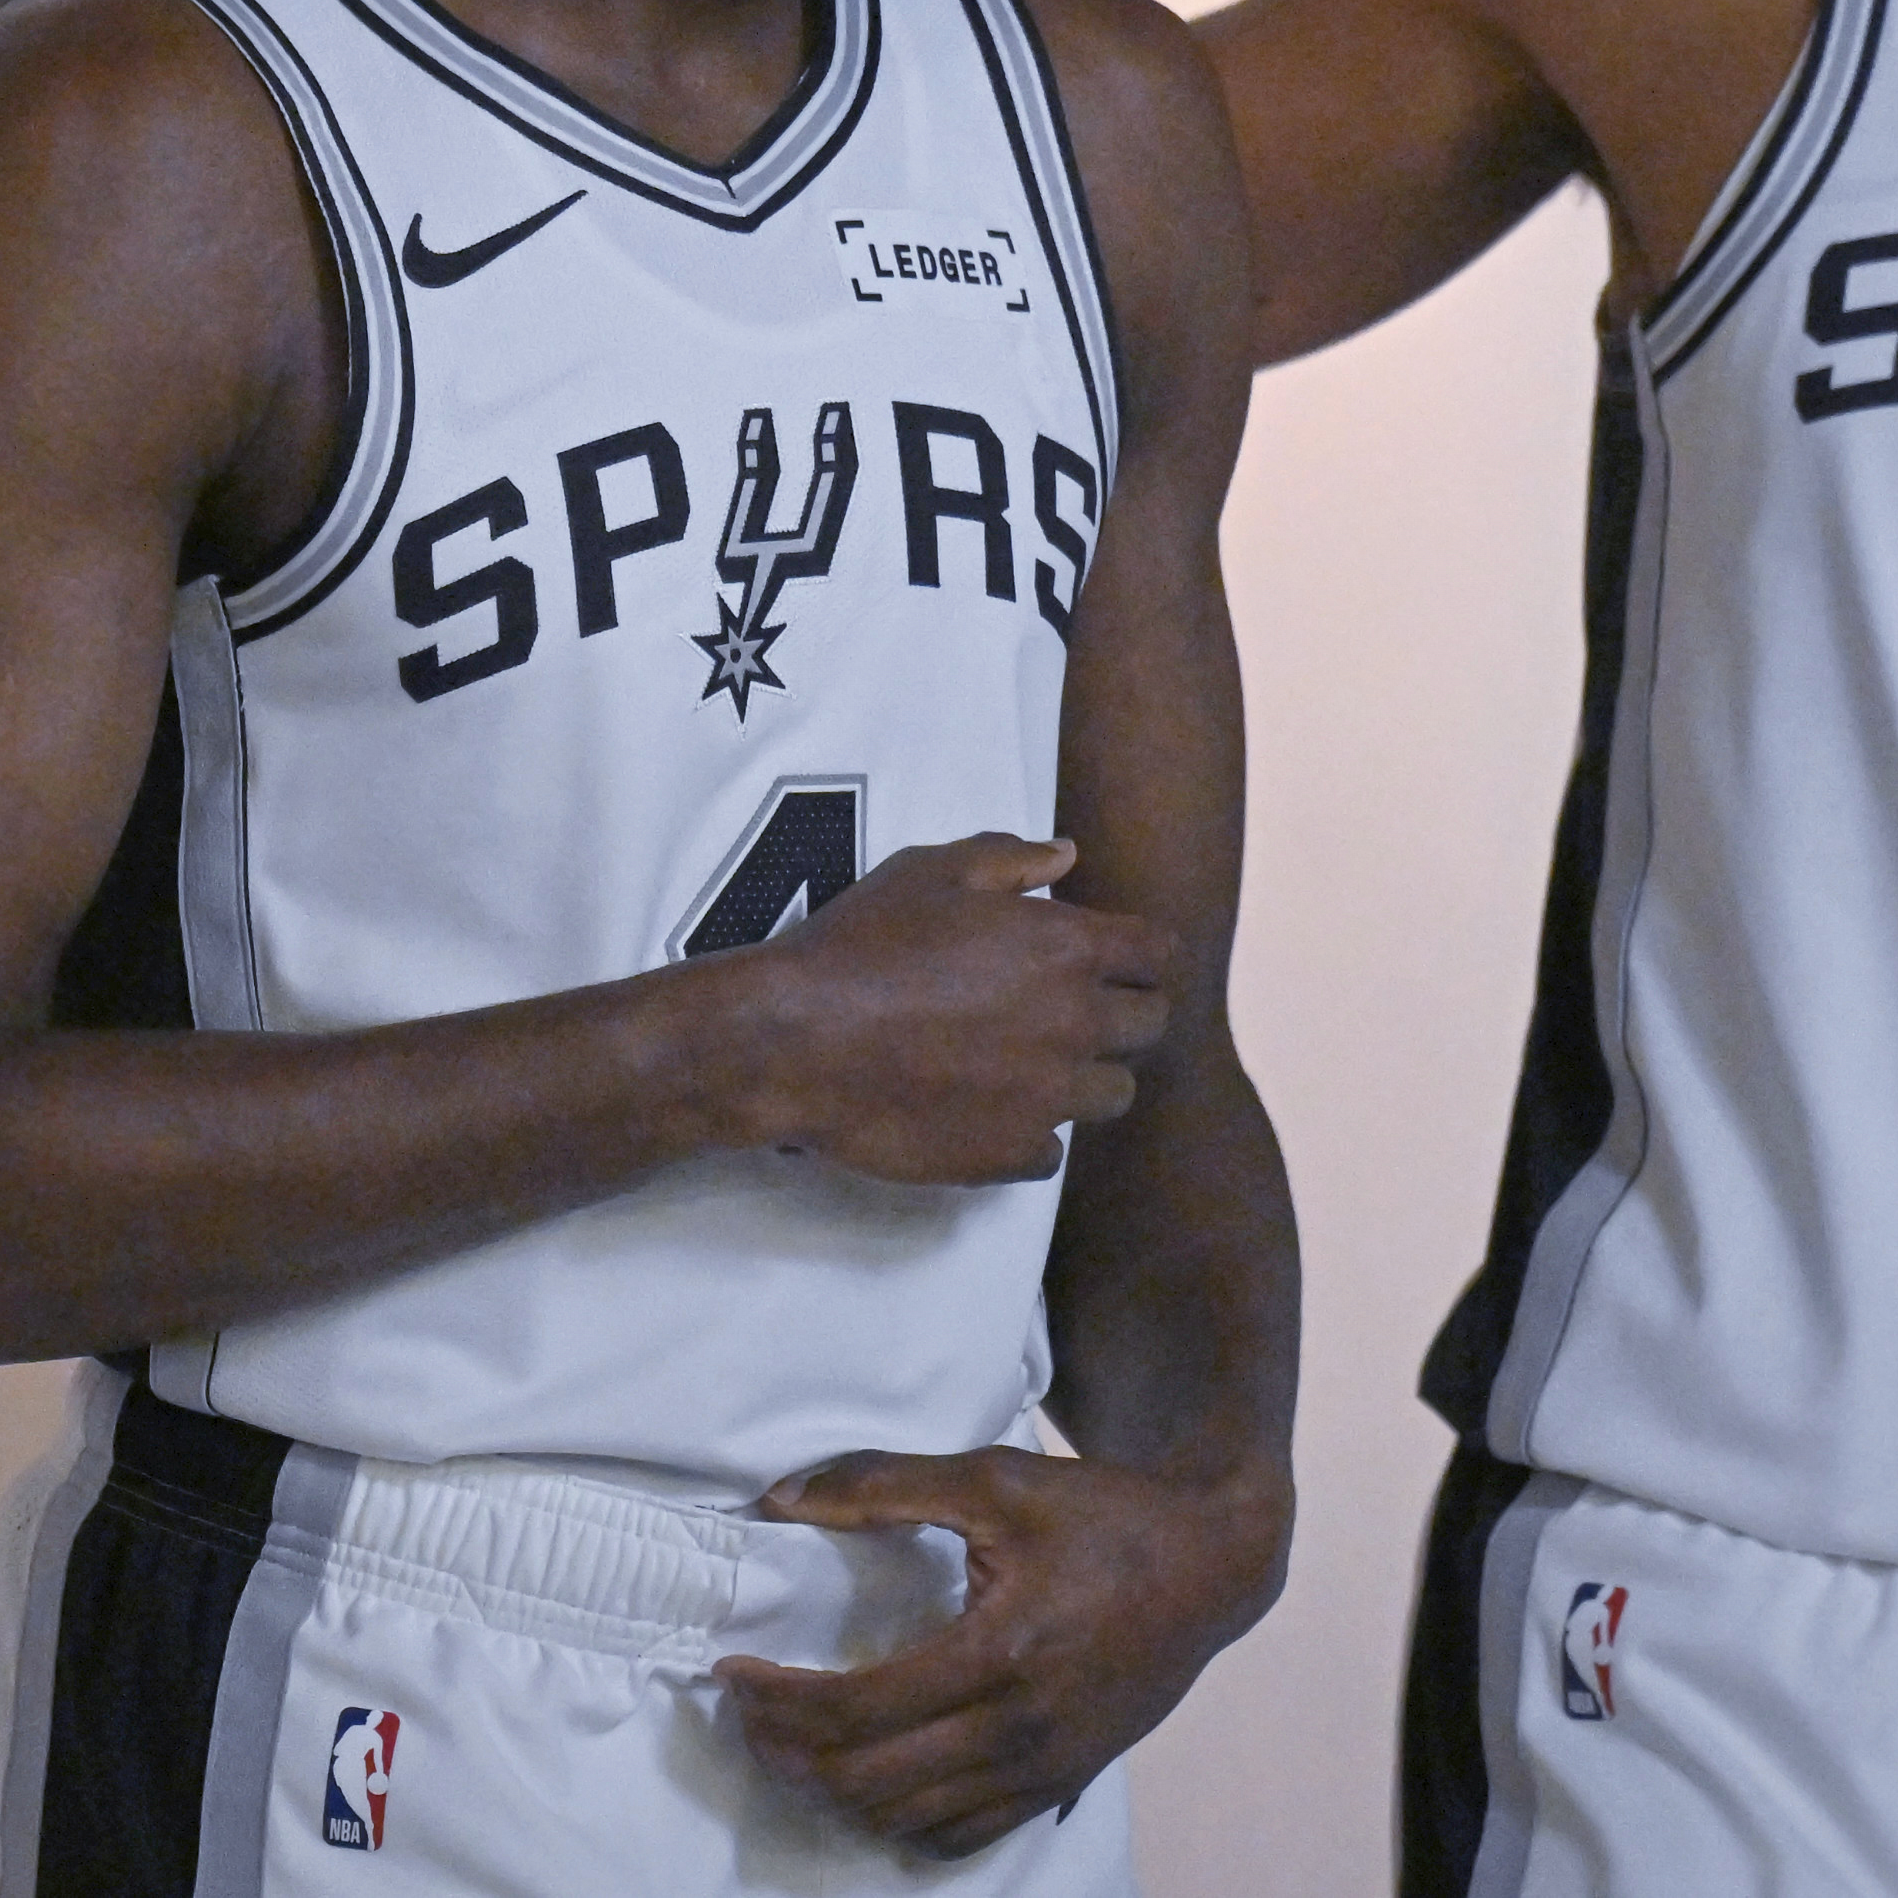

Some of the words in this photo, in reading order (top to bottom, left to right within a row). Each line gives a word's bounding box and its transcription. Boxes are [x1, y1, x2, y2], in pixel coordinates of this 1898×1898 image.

[868, 243, 1004, 287] LEDGER
[391, 400, 1097, 726] SPURS
[329, 1818, 361, 1844] NBA
